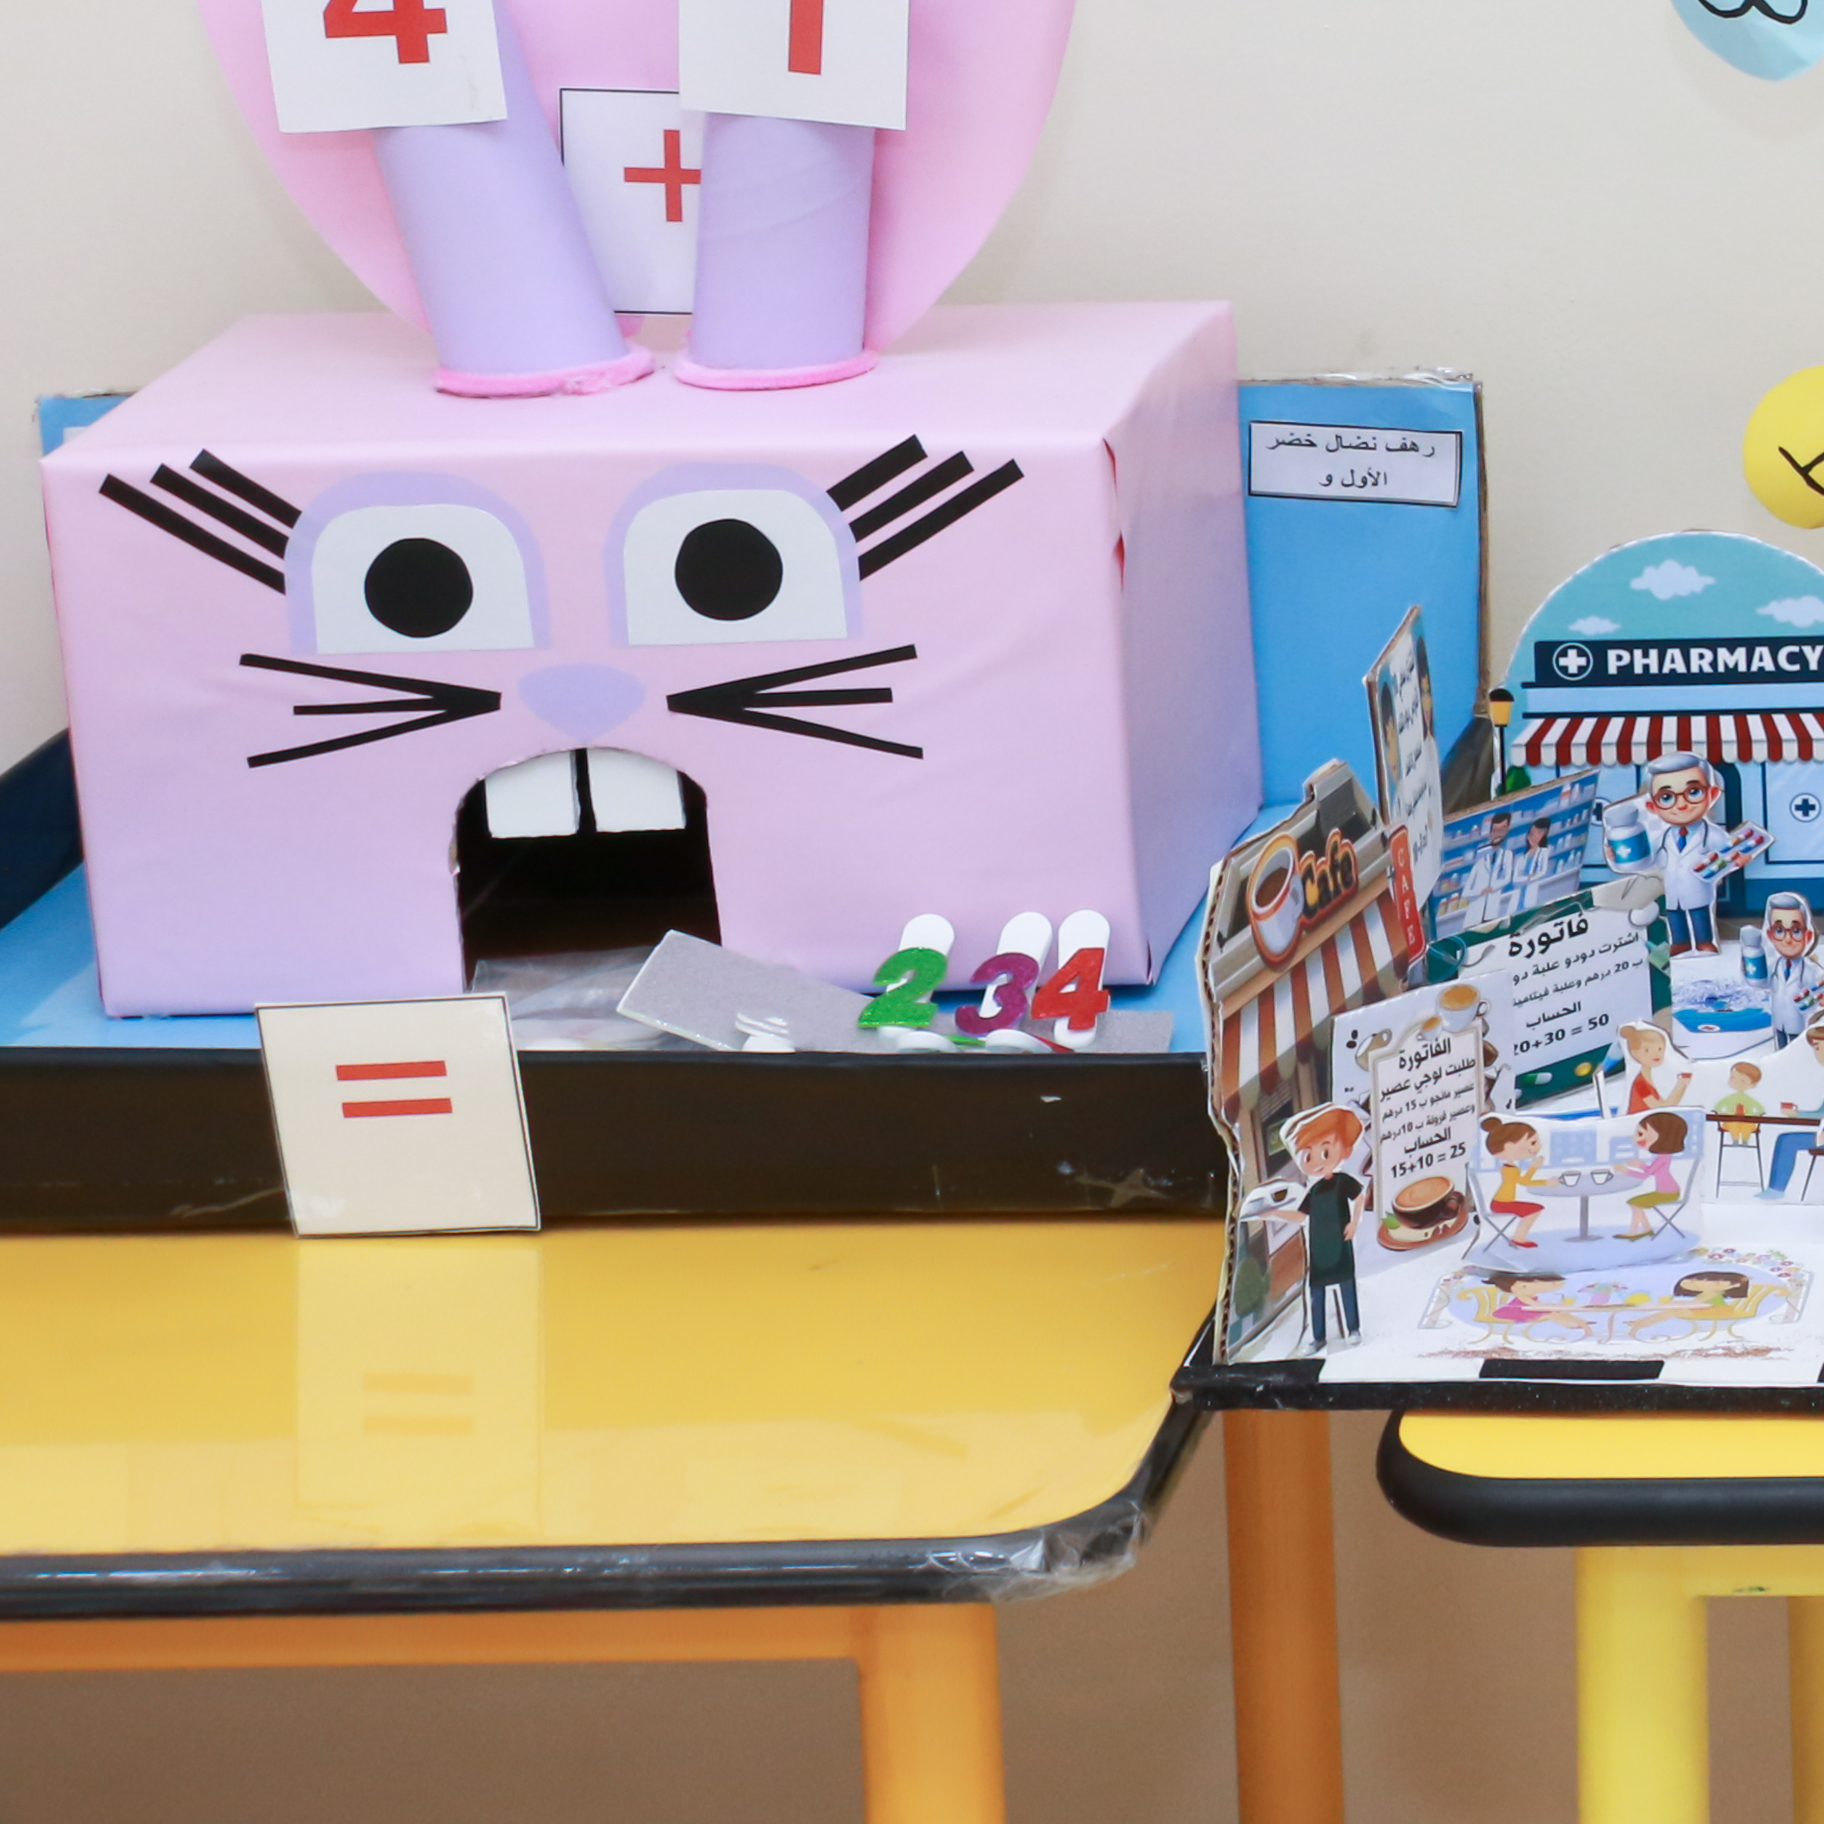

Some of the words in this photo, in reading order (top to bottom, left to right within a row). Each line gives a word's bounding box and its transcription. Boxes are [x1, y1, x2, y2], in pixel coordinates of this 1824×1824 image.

[1265, 432, 1317, 449] خضر
[1325, 434, 1377, 452] نضال
[1385, 437, 1435, 457] رهف
[1341, 468, 1387, 488] الأول
[1605, 645, 1824, 676] PHARMACY
[1301, 834, 1356, 921] Cafe
[1396, 847, 1416, 945] CAFE
[1508, 909, 1589, 959] فاتورة
[1599, 932, 1639, 954] اشترت
[858, 947, 949, 1032] 2
[955, 950, 1040, 1036] 3
[1031, 946, 1111, 1032] 4
[1525, 1001, 1582, 1029] الحساب
[1588, 1013, 1610, 1031] 50
[1399, 1037, 1451, 1071] الفاتورة
[1404, 1126, 1451, 1159] الحساب
[1450, 1141, 1466, 1160] 25
